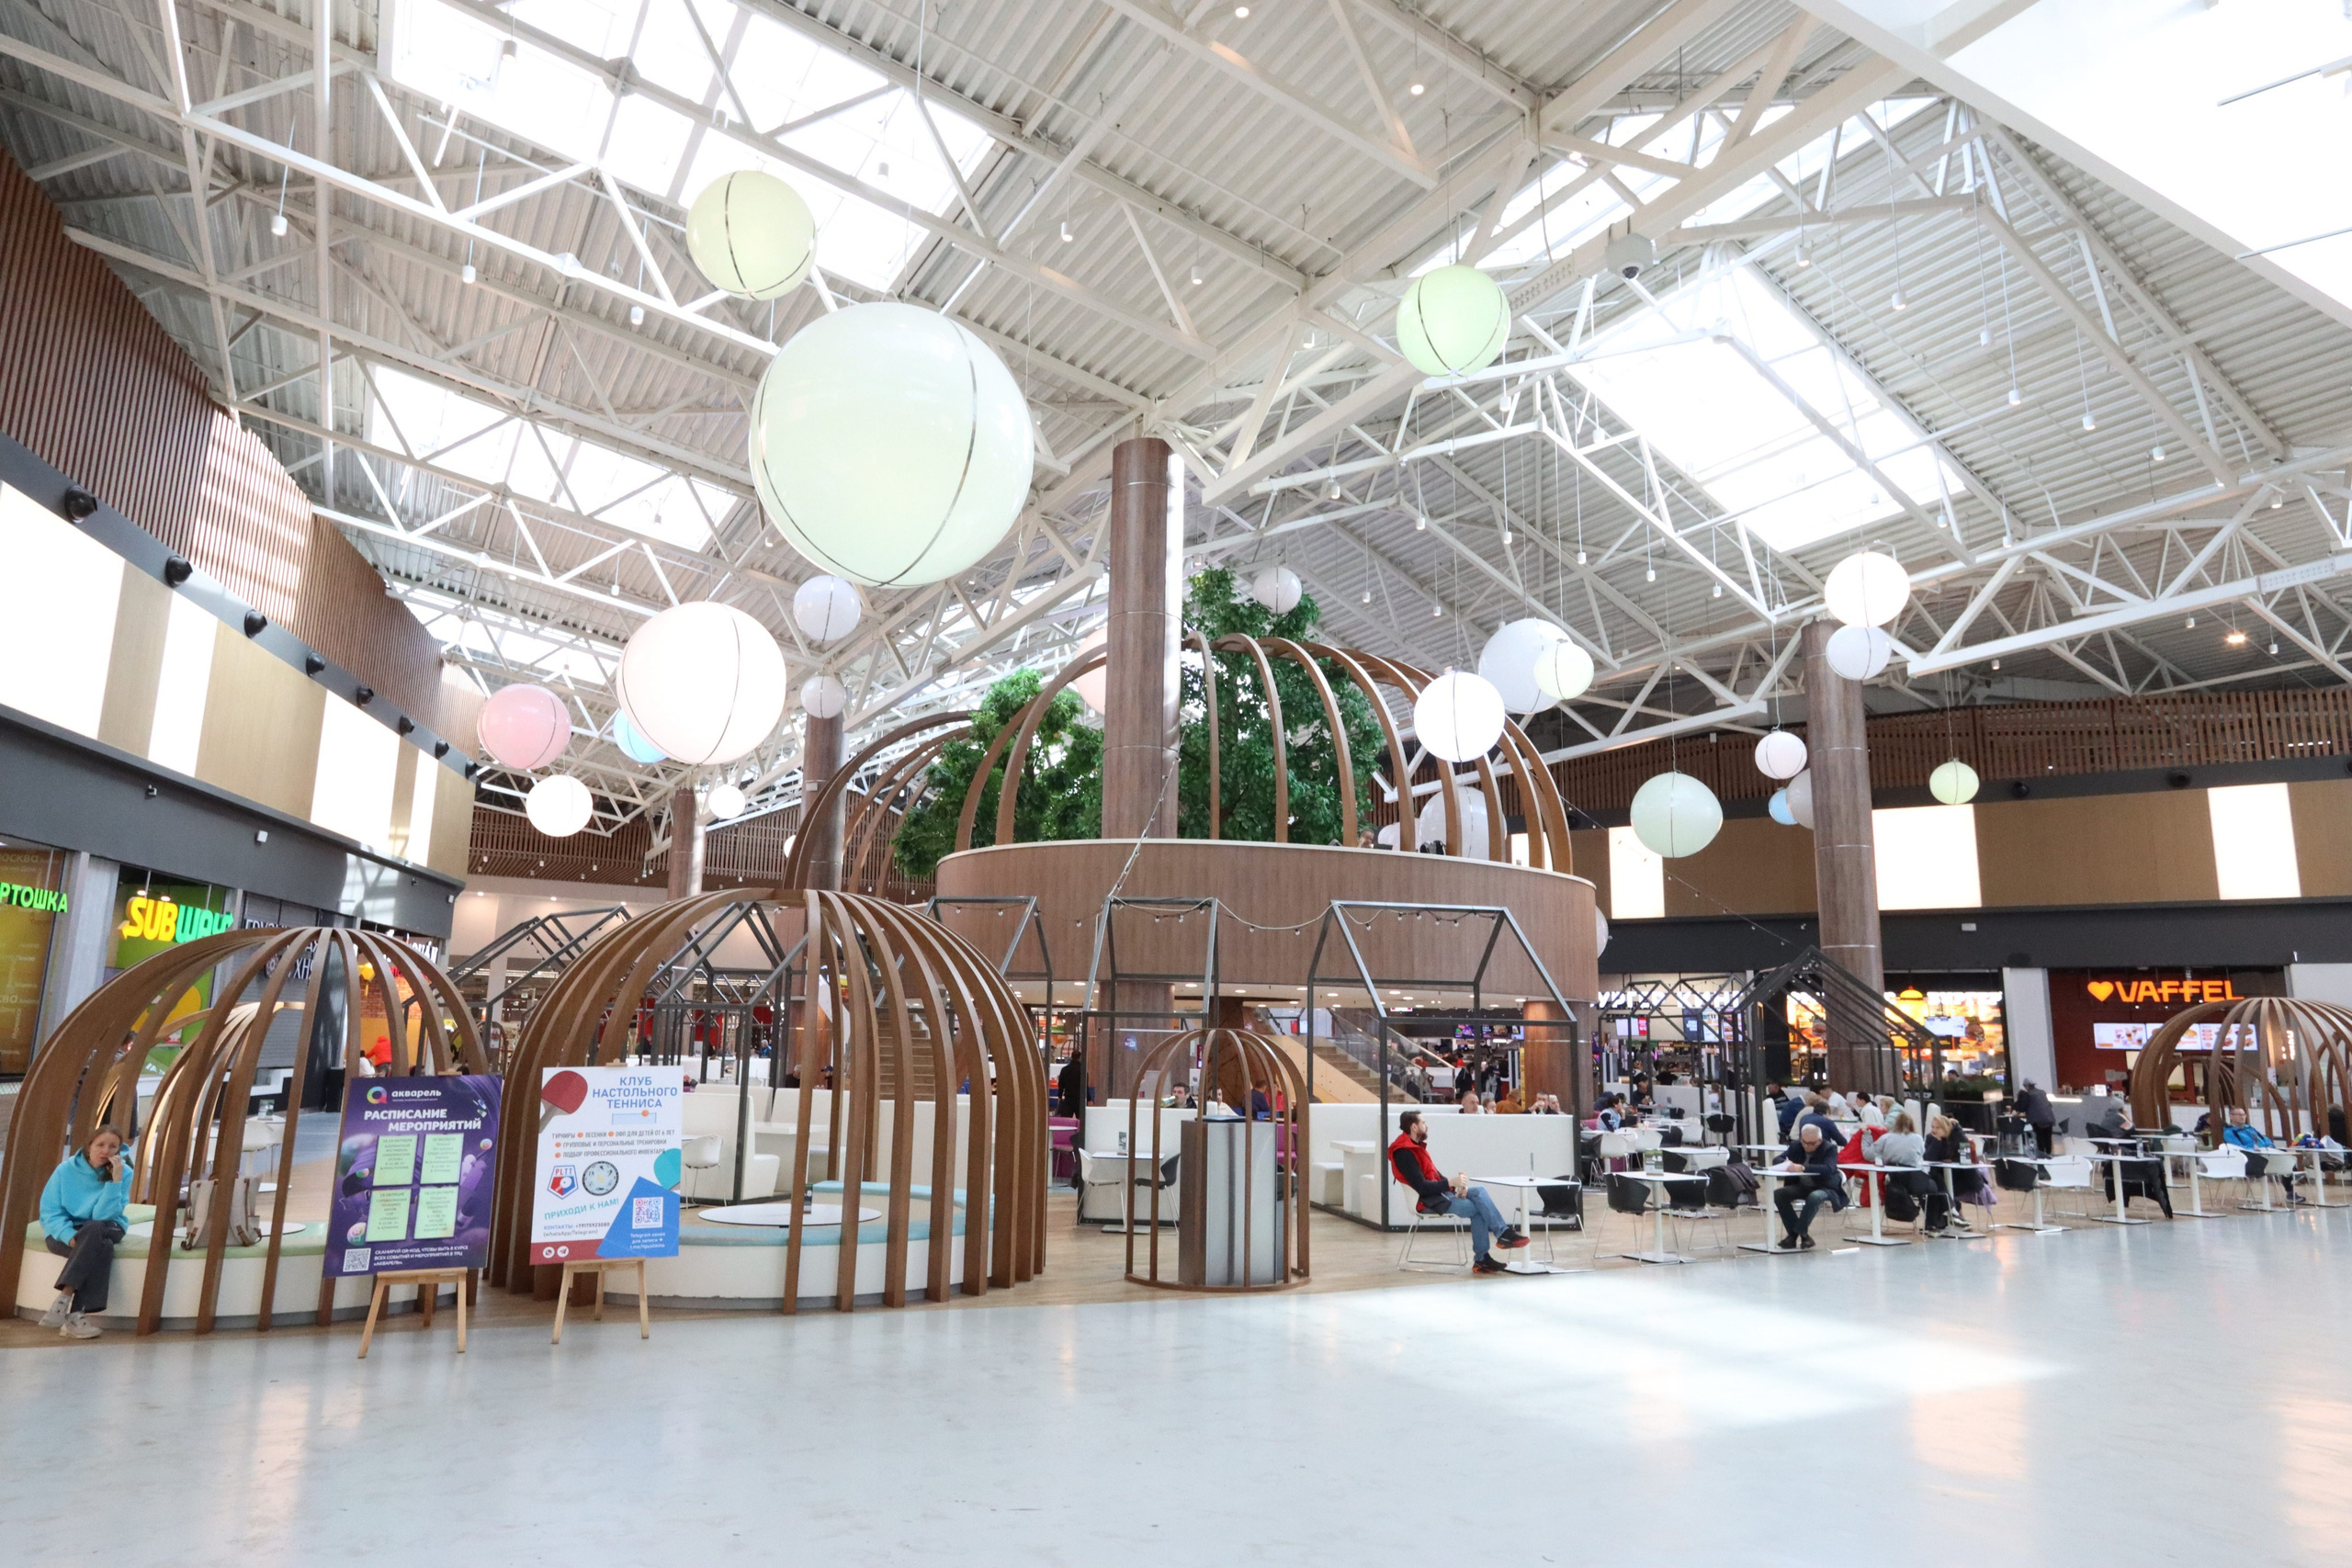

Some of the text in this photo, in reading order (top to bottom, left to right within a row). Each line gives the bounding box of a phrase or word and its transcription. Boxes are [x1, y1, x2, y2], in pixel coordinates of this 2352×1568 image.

[0, 853, 40, 863] осква
[119, 897, 234, 944] SUBWAY
[2115, 980, 2246, 1003] VAFFEL
[1589, 990, 1745, 1009] УРГЕР КИНГ
[619, 1077, 652, 1086] КЛУБ
[391, 1089, 442, 1099] акварель
[593, 1087, 678, 1098] НАСТОЛЬНОГО
[607, 1099, 662, 1109] ТЕННИСА
[364, 1109, 447, 1121] РАСПИСАНИЕ
[388, 1118, 482, 1132] МЕРОПРИЯТИЙ
[583, 1149, 638, 1157] ПРОФЕССИОНАЛЬНОГО
[555, 1168, 573, 1176] PLTT
[544, 1204, 587, 1221] ПРИХОДИ
[597, 1198, 619, 1209] НАМ!
